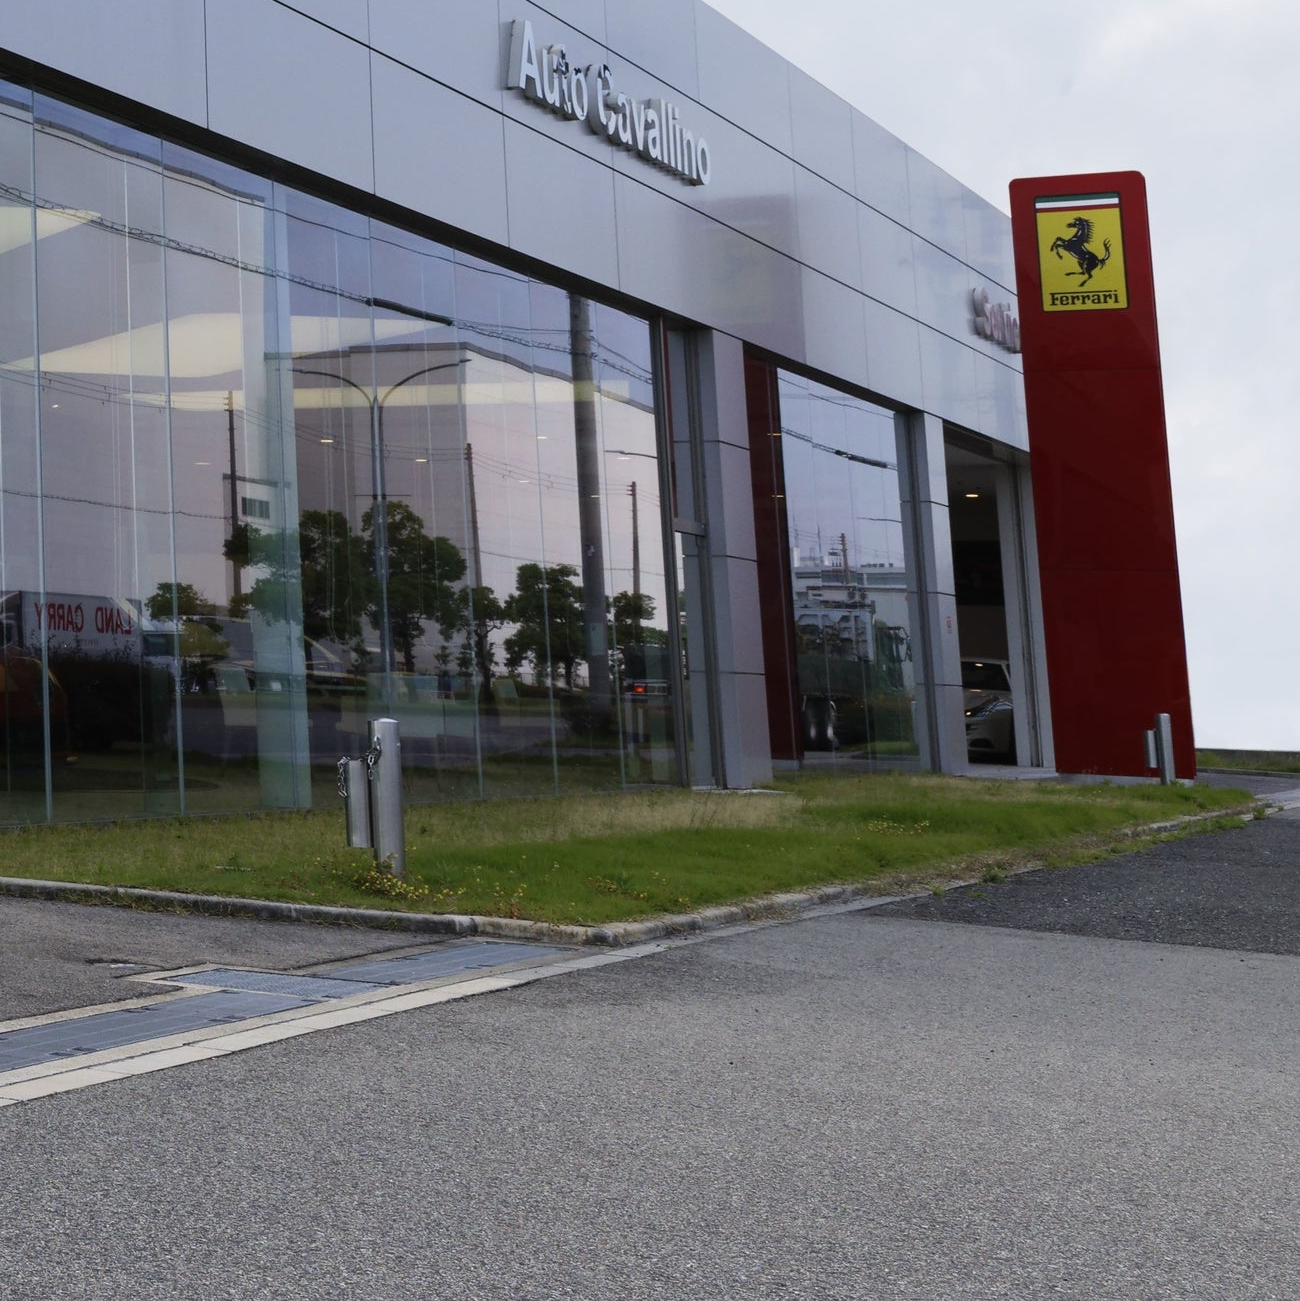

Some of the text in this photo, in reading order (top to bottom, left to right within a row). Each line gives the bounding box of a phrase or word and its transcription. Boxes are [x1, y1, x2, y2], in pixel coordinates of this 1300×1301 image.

[508, 19, 711, 186] Auto Cavallino
[1049, 290, 1120, 307] Ferrari
